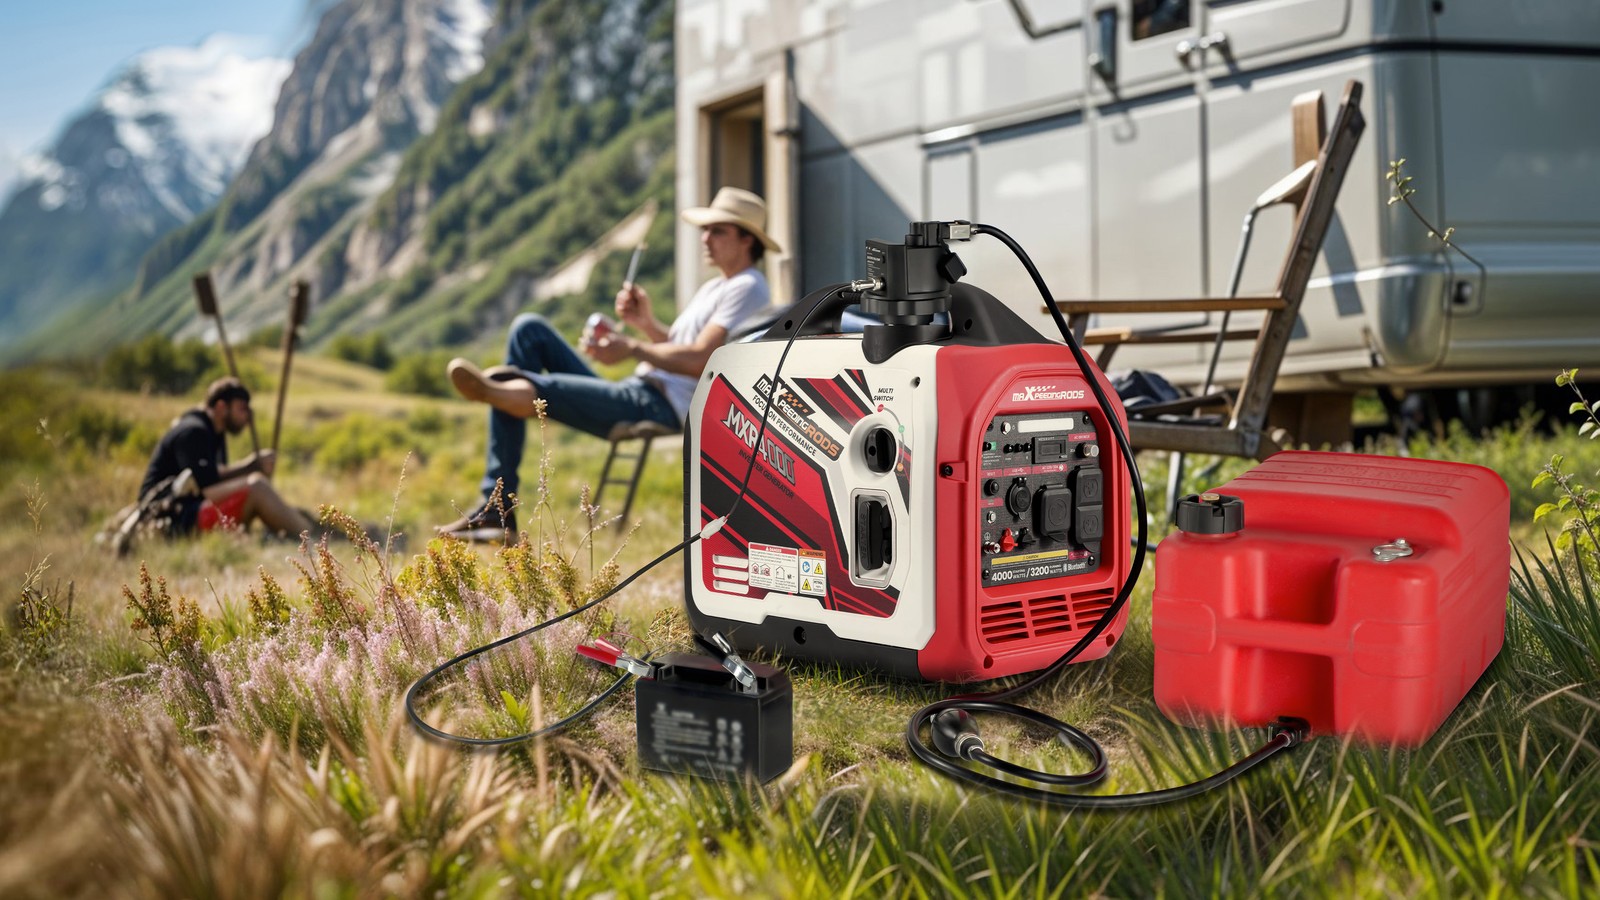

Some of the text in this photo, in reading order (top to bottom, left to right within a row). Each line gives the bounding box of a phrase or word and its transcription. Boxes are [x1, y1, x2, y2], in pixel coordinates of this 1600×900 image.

[775, 417, 817, 457] PERFORMANCE
[738, 449, 795, 499] INVETER GENERATOR
[992, 571, 1013, 581] 4000
[1030, 565, 1050, 577] 3200
[1068, 562, 1086, 571] Bluetooth
